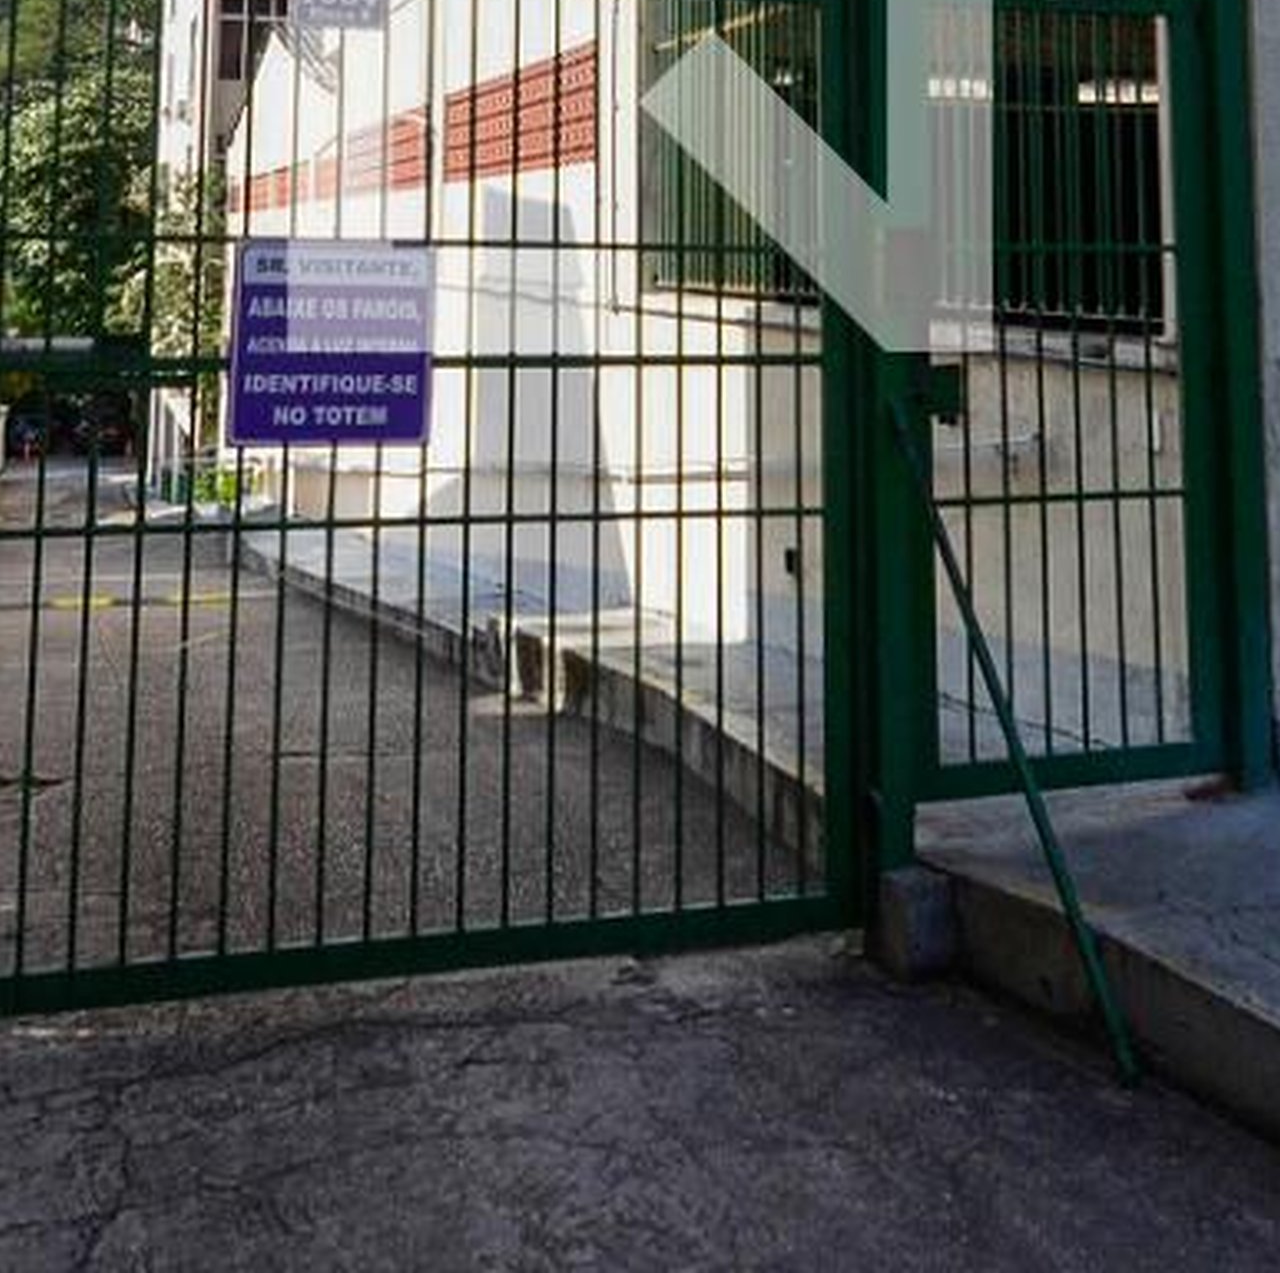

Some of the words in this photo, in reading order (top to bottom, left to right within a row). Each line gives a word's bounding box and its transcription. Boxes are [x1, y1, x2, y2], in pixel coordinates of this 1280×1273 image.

[248, 297, 318, 319] ABAIXE
[243, 374, 417, 395] IDENTIFIQUE-SE
[272, 406, 307, 426] NO
[313, 406, 388, 426] TOTEM
